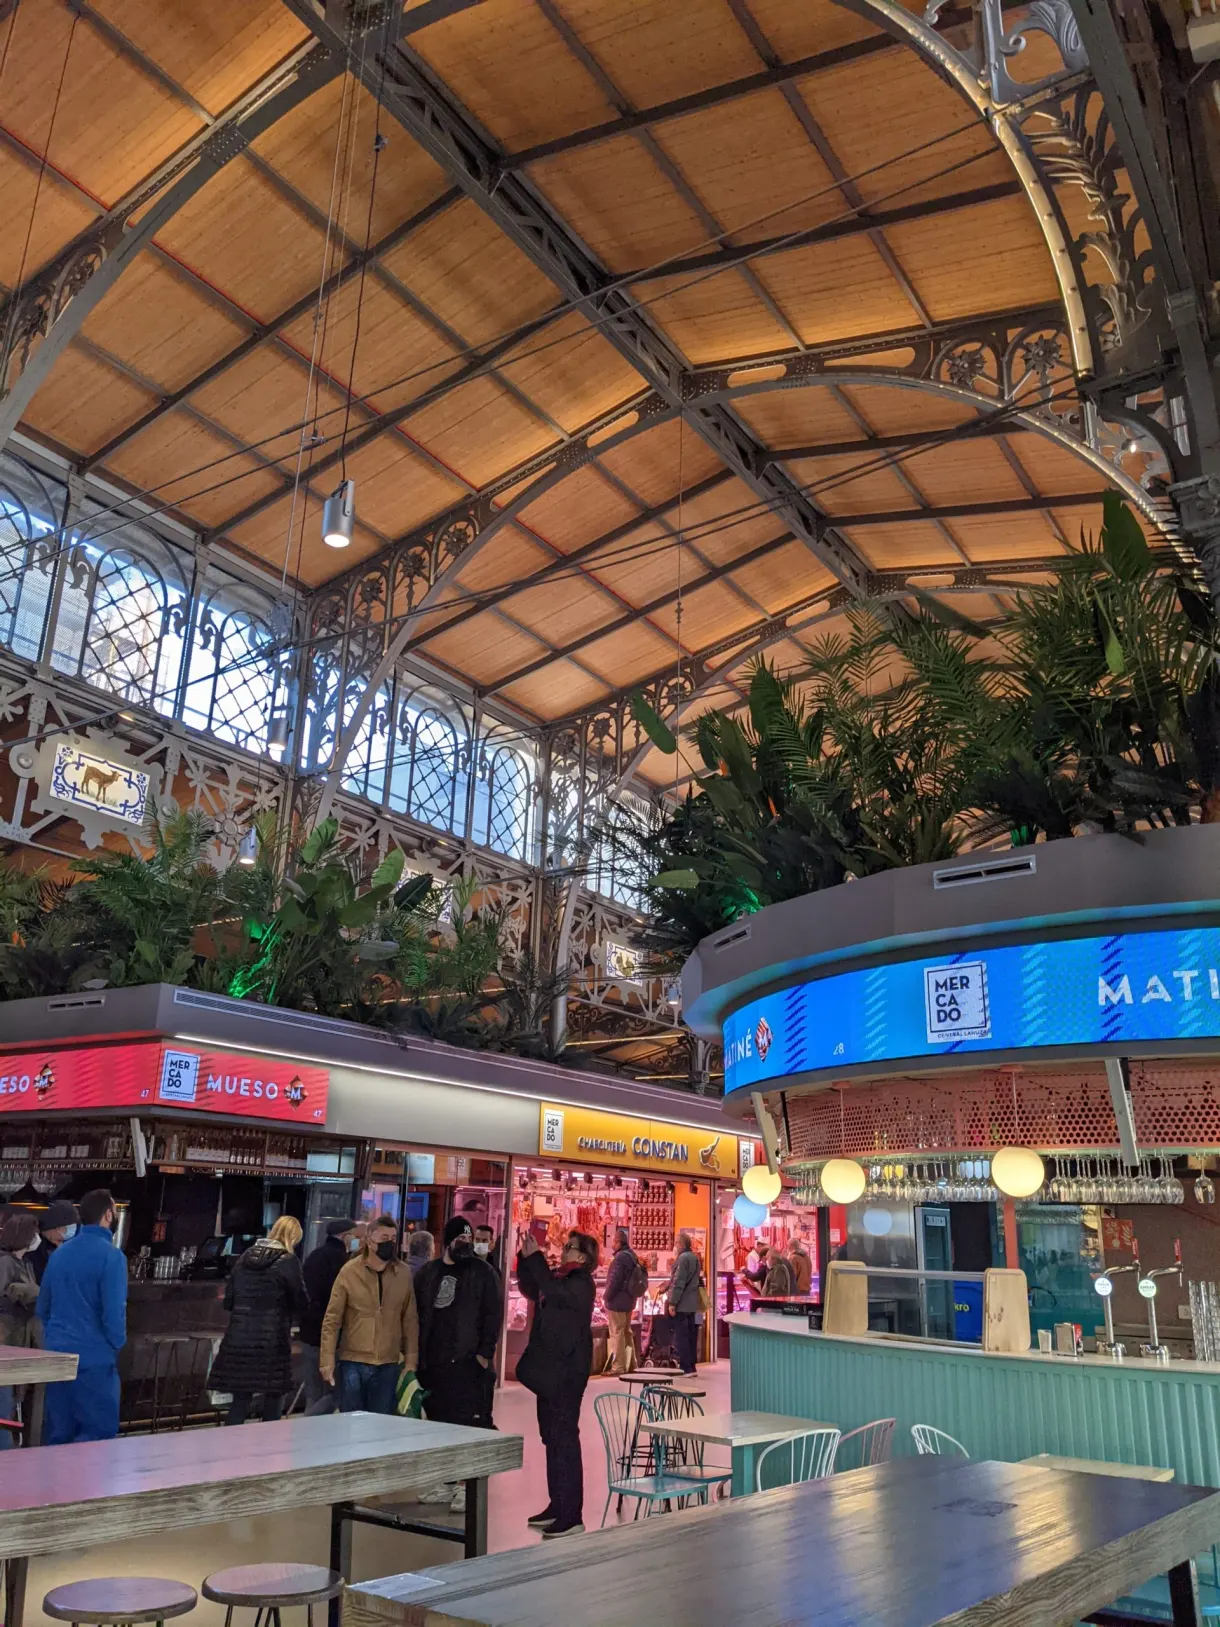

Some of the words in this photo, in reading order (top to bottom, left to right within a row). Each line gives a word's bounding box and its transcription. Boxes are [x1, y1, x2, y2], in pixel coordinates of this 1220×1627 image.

[934, 975, 970, 992] MER
[1098, 968, 1220, 1006] MATI
[935, 993, 959, 1007] CA
[936, 1008, 961, 1023] DO
[169, 1059, 190, 1070] MER
[168, 1069, 181, 1079] CA
[0, 1075, 30, 1094] ESO
[167, 1079, 182, 1088] DO
[206, 1073, 279, 1099] MUESO
[313, 1110, 322, 1118] 47
[547, 1118, 559, 1127] MER
[547, 1126, 555, 1134] CA
[547, 1134, 556, 1142] DO
[632, 1136, 688, 1163] CONSTAN
[954, 1303, 970, 1312] kro
